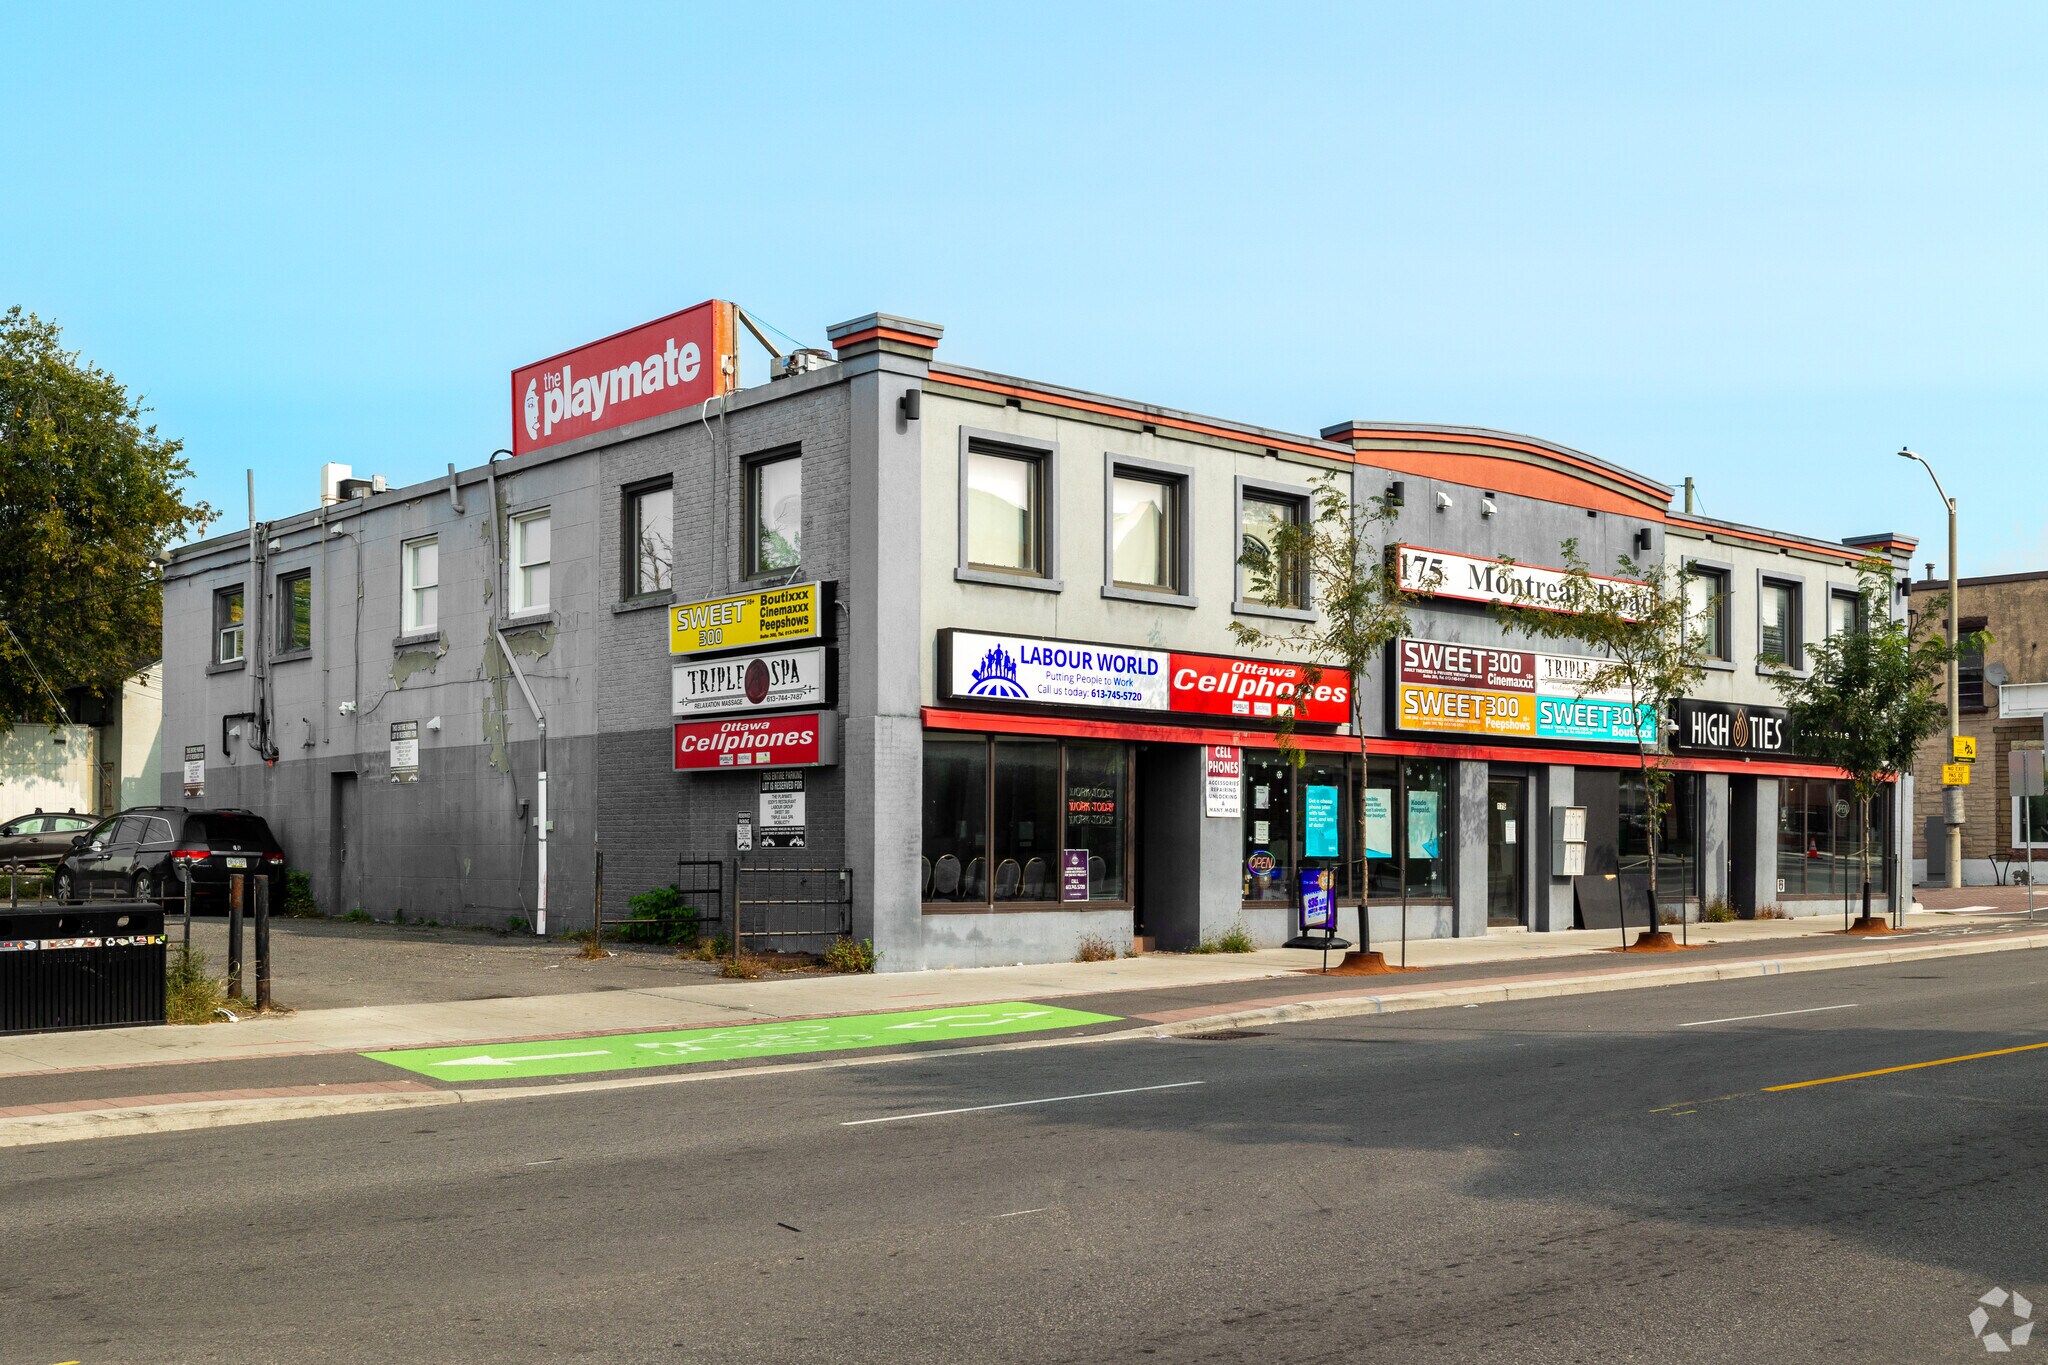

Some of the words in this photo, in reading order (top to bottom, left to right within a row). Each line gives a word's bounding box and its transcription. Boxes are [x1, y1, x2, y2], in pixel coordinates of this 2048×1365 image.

[544, 372, 561, 390] the
[544, 338, 700, 436] playmate
[1400, 554, 1442, 584] 175
[760, 590, 809, 606] Boutixxx
[677, 600, 746, 631] SWEET
[760, 602, 809, 618] Cinemaxxx
[760, 614, 809, 632] Peepshows
[699, 628, 722, 647] 300
[1020, 645, 1093, 670] LABOUR
[1097, 654, 1158, 675] WORLD
[688, 664, 744, 694] TRIPLE
[772, 658, 800, 686] SPA
[1232, 662, 1296, 677] Ottawa
[1046, 671, 1074, 684] Putting
[1076, 674, 1102, 687] People
[1104, 677, 1112, 685] to
[1114, 677, 1133, 687] Work
[1487, 673, 1533, 688] Cinemaxxx
[1037, 684, 1051, 694] Call
[1054, 687, 1062, 695] us
[1064, 687, 1089, 699] today:
[1091, 689, 1142, 701] 613-745-5720
[694, 701, 720, 709] RELAXATION
[721, 699, 743, 708] MASSAGE
[720, 722, 770, 732] Ottawa
[1486, 717, 1530, 731] Peepshows
[1612, 726, 1652, 738] Boutixx
[1692, 711, 1729, 746] HIGH
[1750, 716, 1782, 749] TIES
[681, 730, 814, 753] Cellphones
[1215, 746, 1231, 758] CELL
[1209, 761, 1238, 774] PHONES
[1069, 802, 1090, 812] WORK
[1092, 802, 1114, 812] TODAY
[1251, 856, 1273, 868] OPEN
